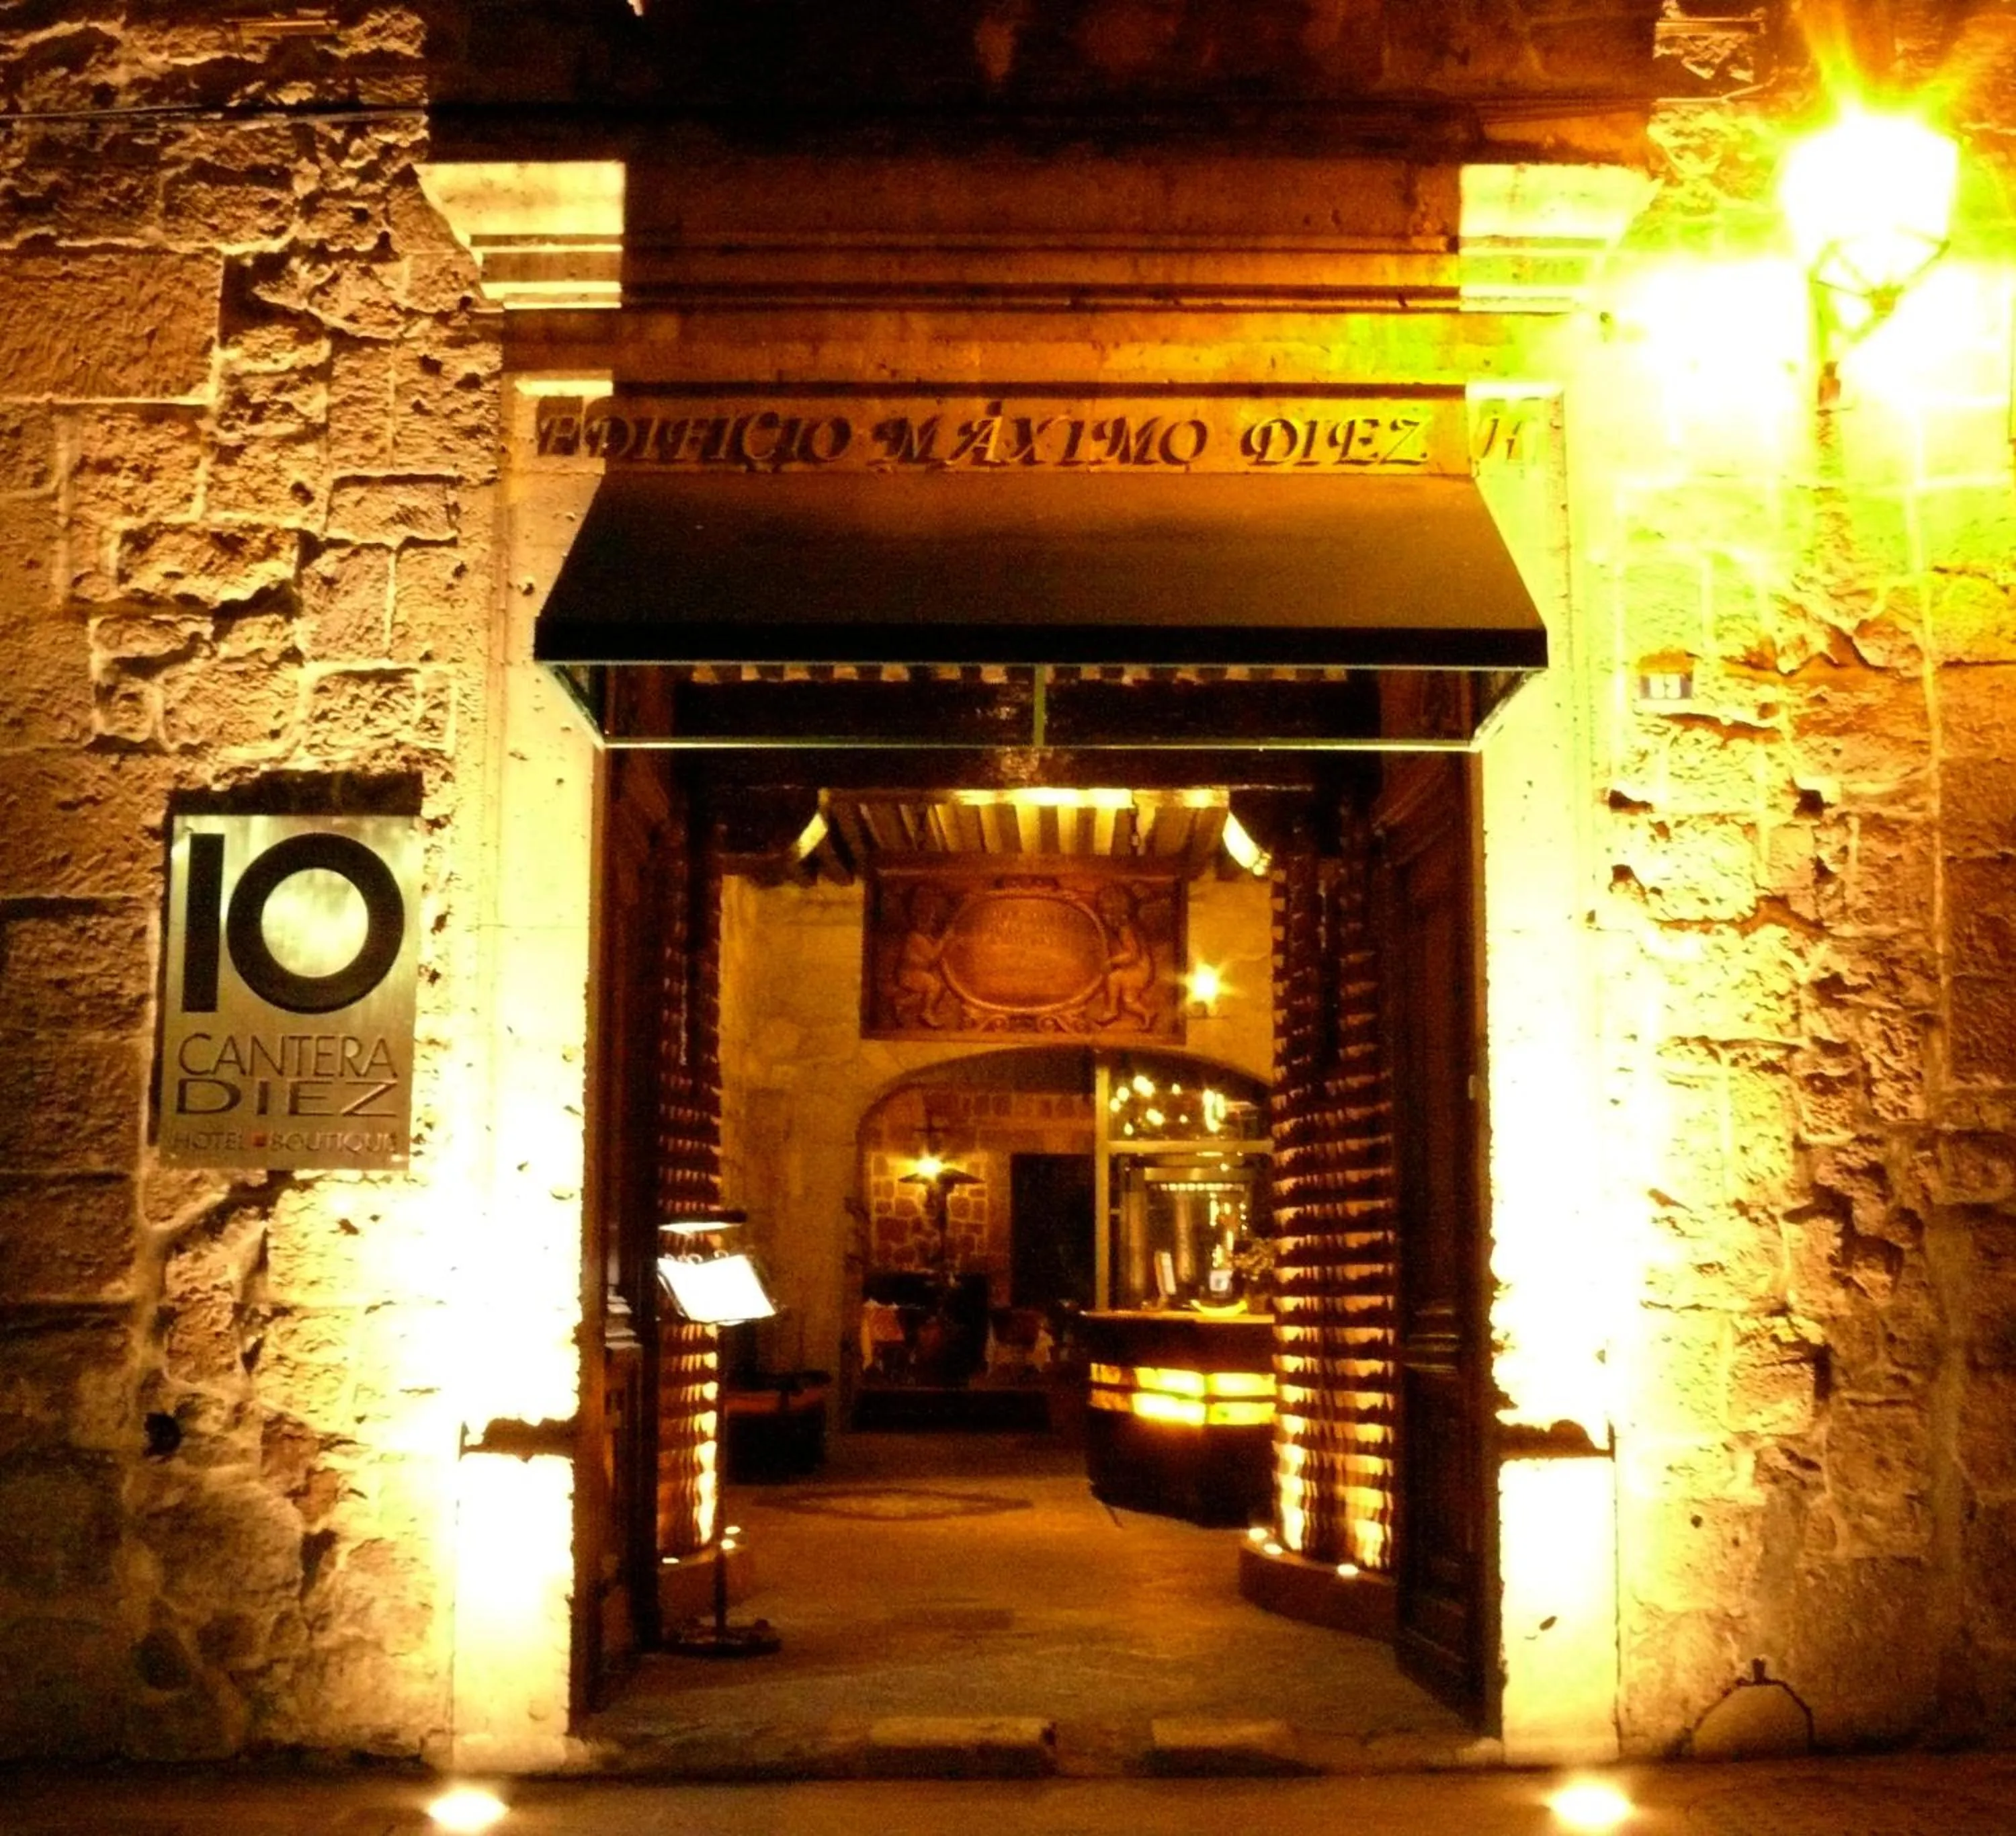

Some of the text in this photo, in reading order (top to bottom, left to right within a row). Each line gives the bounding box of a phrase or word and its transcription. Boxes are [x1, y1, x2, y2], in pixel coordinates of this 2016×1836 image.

[538, 411, 852, 466] EDIFICIO
[1239, 413, 1429, 466] DIEZ
[181, 832, 405, 1014] 10
[177, 1033, 398, 1077] CANTERA
[176, 1078, 398, 1117] DIEZ
[173, 1131, 398, 1156] HOTEL BOUTIQUE
